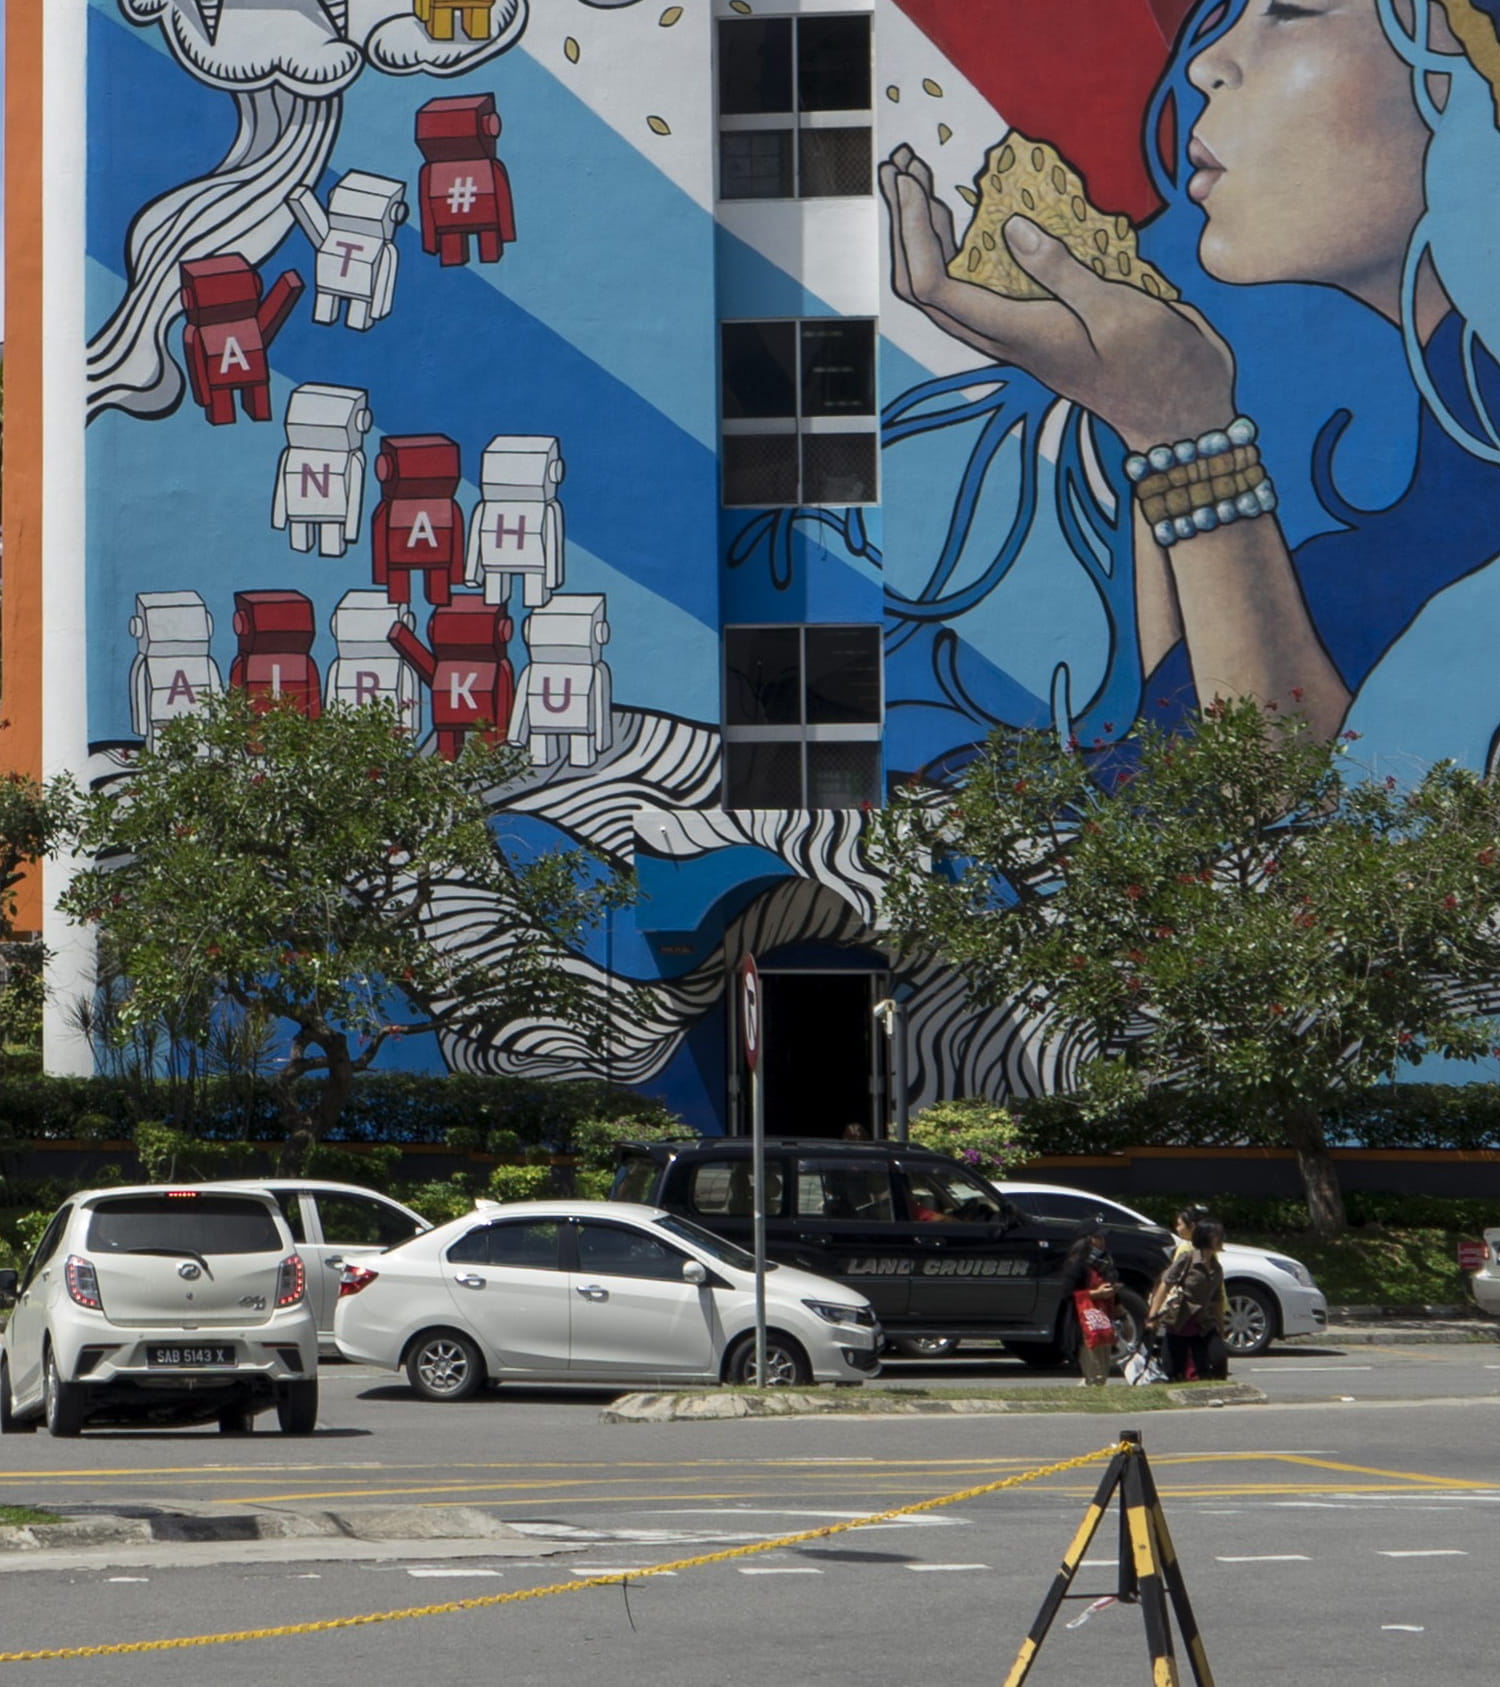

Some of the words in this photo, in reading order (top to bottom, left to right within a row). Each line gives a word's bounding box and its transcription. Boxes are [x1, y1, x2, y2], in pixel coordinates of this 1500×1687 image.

[847, 1258, 914, 1275] LAND
[922, 1259, 1030, 1276] CRUISER
[156, 1349, 180, 1363] SAB
[183, 1348, 212, 1362] 5143
[216, 1349, 225, 1362] X
